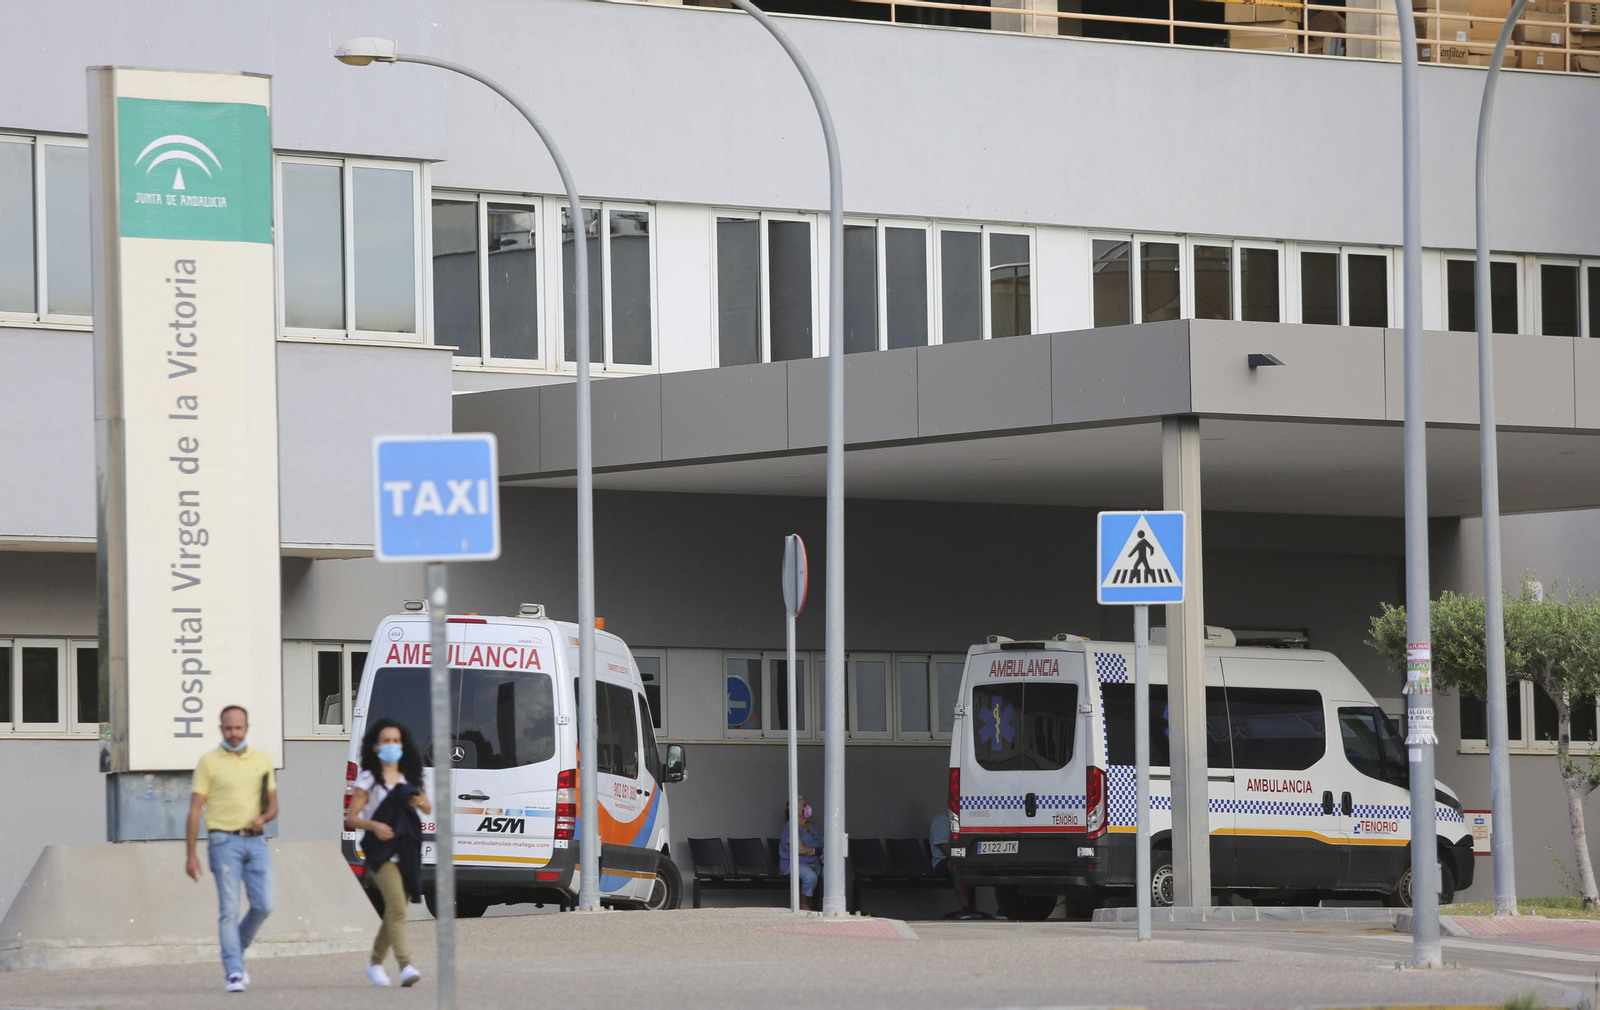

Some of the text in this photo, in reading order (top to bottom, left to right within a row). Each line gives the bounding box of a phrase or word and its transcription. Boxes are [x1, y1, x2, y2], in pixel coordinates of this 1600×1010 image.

[1440, 46, 1466, 60] enfilter
[134, 192, 228, 208] JUNTA DE ANDALUCIA
[165, 258, 211, 738] Hospital Virgen de la Victoria
[382, 479, 489, 517] TAXI
[988, 659, 1060, 677] AMBULANCIA
[1246, 778, 1313, 793] AMBULANCIA
[476, 817, 525, 834] ASM
[1052, 815, 1078, 825] TENORIO
[1360, 820, 1398, 832] TENORIO
[457, 839, 550, 848] www.ambulancias-malaga.com
[982, 842, 1017, 853] 2122 JTK
